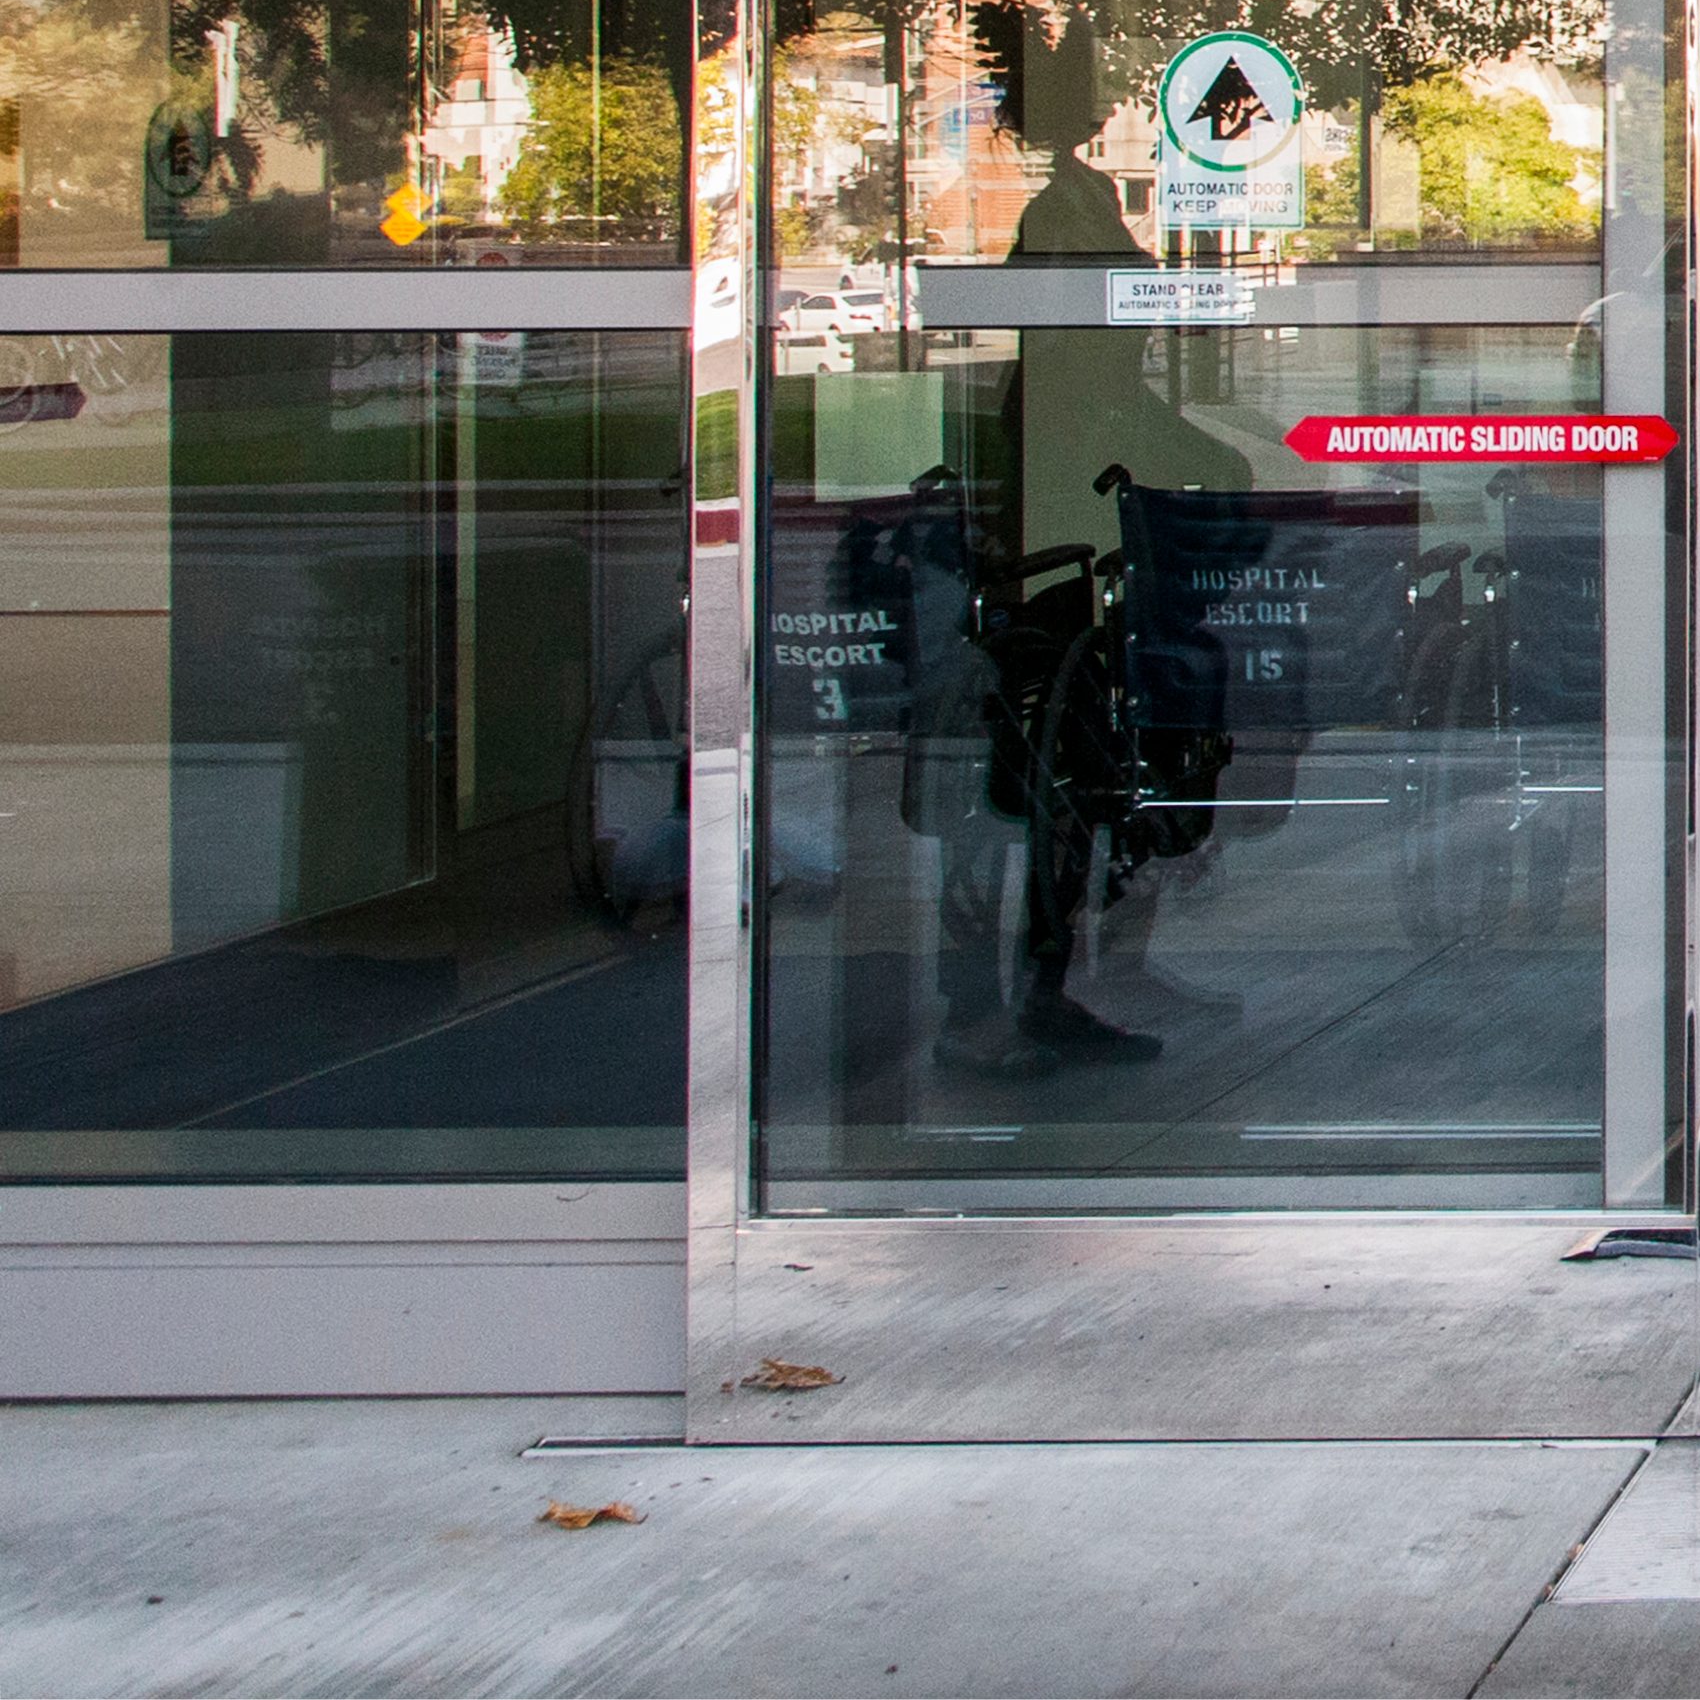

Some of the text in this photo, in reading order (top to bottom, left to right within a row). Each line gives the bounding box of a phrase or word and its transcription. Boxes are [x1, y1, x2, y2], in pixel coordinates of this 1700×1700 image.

[1167, 182, 1293, 195] AUTOMATIC DOOR
[1173, 200, 1288, 213] KEEP VING
[1132, 283, 1177, 296] STAND
[1118, 300, 1171, 309] AUTOMATIC
[1174, 300, 1210, 309] SING
[1327, 425, 1638, 453] AUTOMATIC SLIDING DOOR
[1192, 567, 1326, 591] HOSPITAL
[1205, 601, 1309, 625] ESCORT
[775, 642, 885, 668] ESCORT
[1245, 649, 1283, 681] 15
[813, 679, 848, 720] 3
